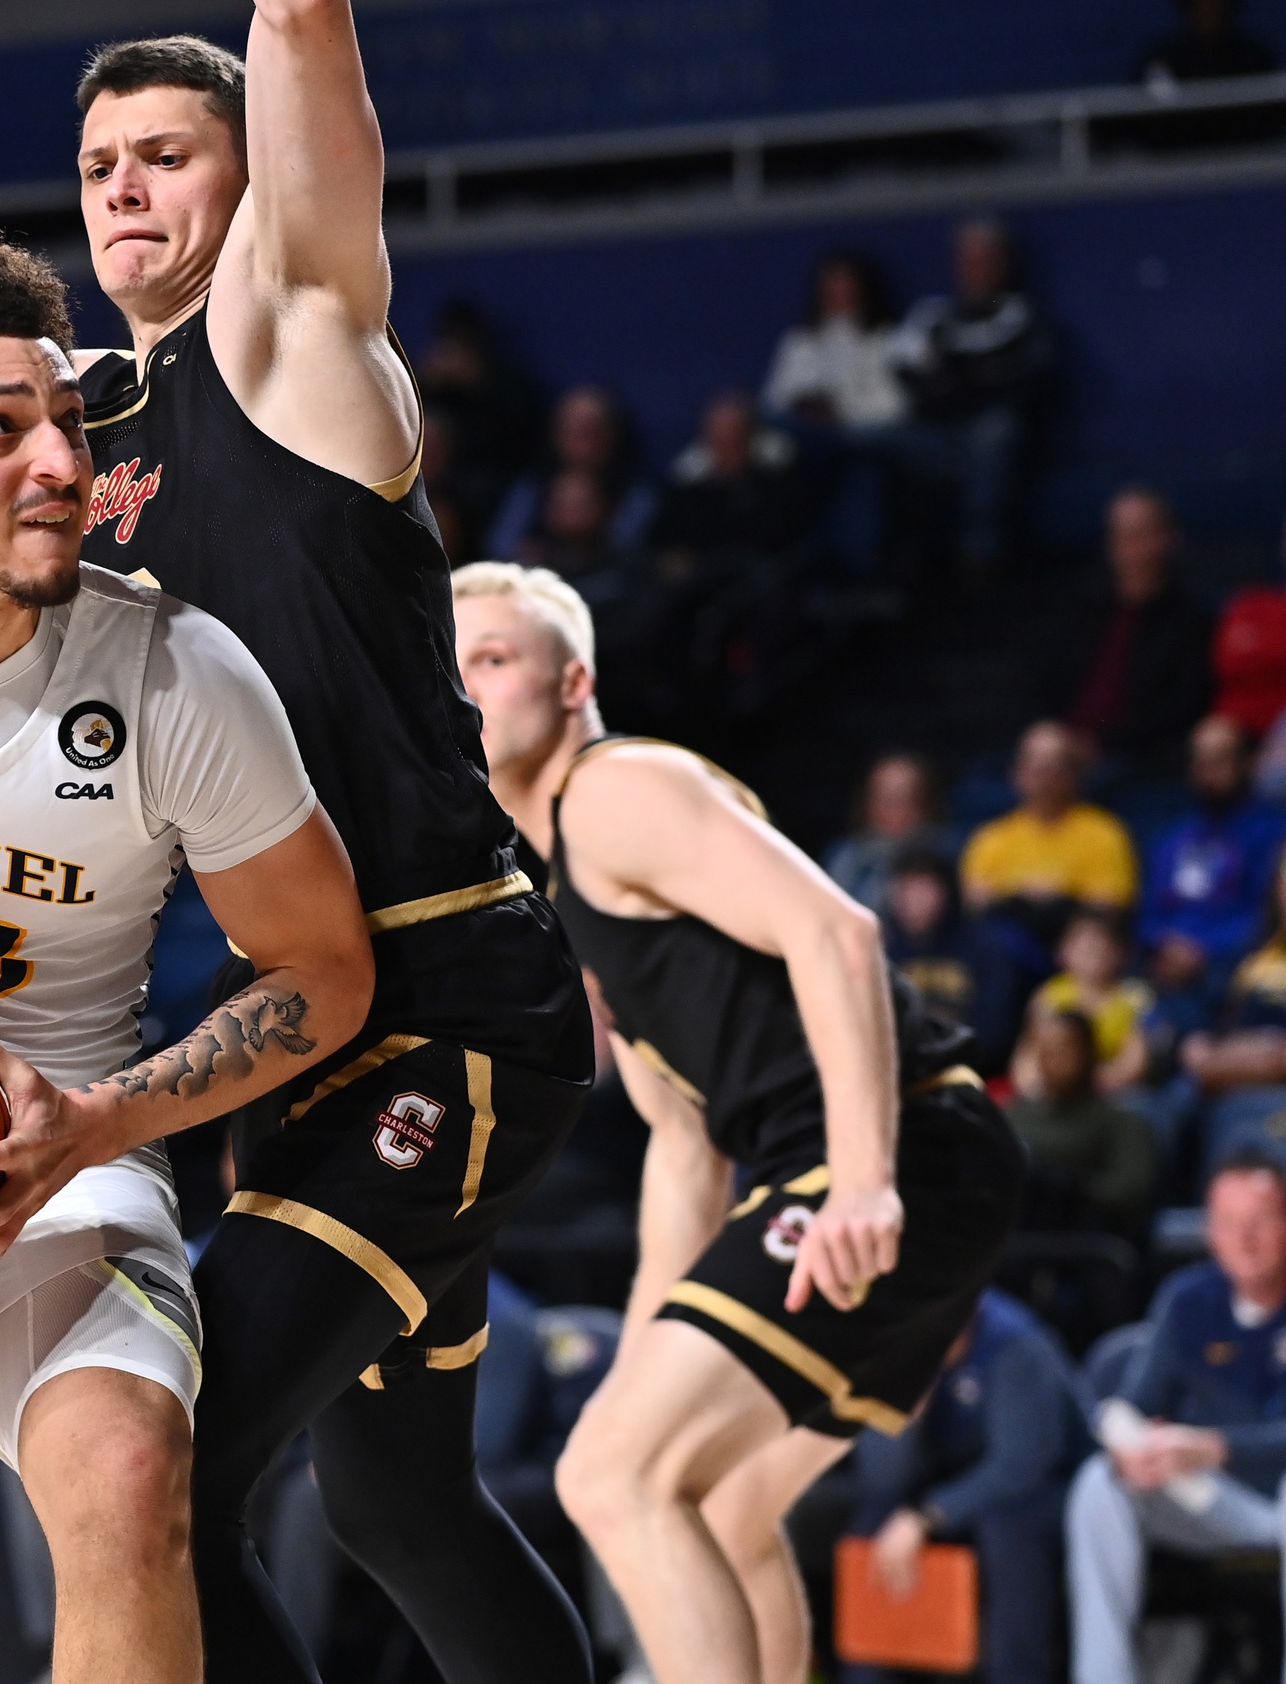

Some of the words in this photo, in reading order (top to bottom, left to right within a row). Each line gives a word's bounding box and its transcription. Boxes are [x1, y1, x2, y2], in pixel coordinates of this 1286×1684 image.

[65, 746, 87, 766] United
[55, 782, 114, 800] CAA
[377, 1113, 434, 1149] CHARLESTON
